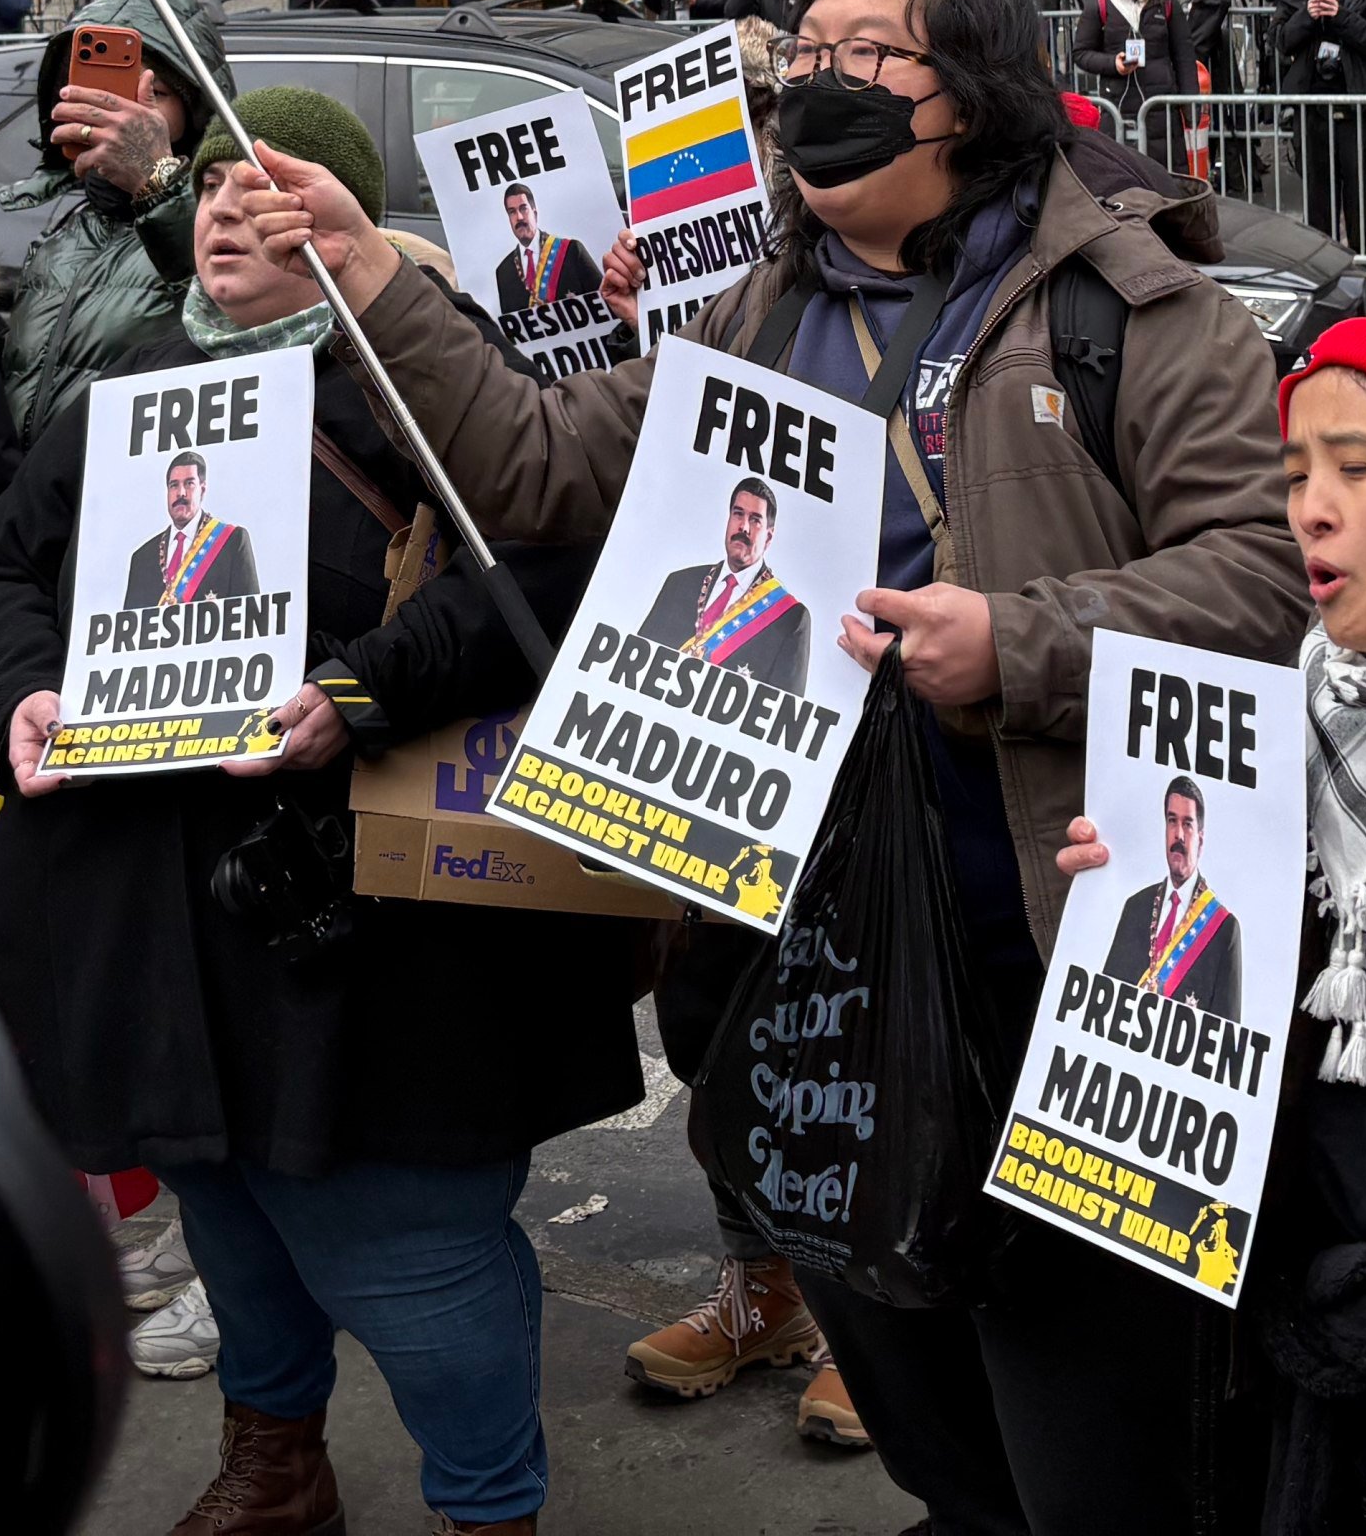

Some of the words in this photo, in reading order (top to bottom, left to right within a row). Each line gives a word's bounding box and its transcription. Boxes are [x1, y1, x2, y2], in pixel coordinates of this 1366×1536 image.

[620, 35, 738, 123] FREE
[454, 116, 566, 192] FREE
[636, 201, 768, 291] PRESIDENT
[497, 292, 617, 346] RESIDE
[129, 375, 260, 457] FREE
[693, 376, 838, 503] FREE
[86, 591, 292, 656] PRESIDENT
[81, 652, 273, 716] MADURO
[578, 622, 840, 762] PRESIDENT
[1126, 667, 1257, 790] FREE
[46, 741, 170, 767] AGAINST
[173, 735, 239, 759] WAR
[55, 717, 202, 745] BROOKLYN
[554, 690, 792, 832] MADURO
[502, 780, 650, 857] AGAINST
[650, 842, 731, 895] WAR
[514, 752, 693, 843] BROOKLYN
[432, 844, 524, 883] FedEx
[1055, 963, 1271, 1099] PRESIDENT
[1038, 1044, 1239, 1187] MADURO
[1007, 1120, 1157, 1207] BROOKLYN
[996, 1154, 1120, 1230] AGAINST
[1120, 1209, 1192, 1265] WAR
